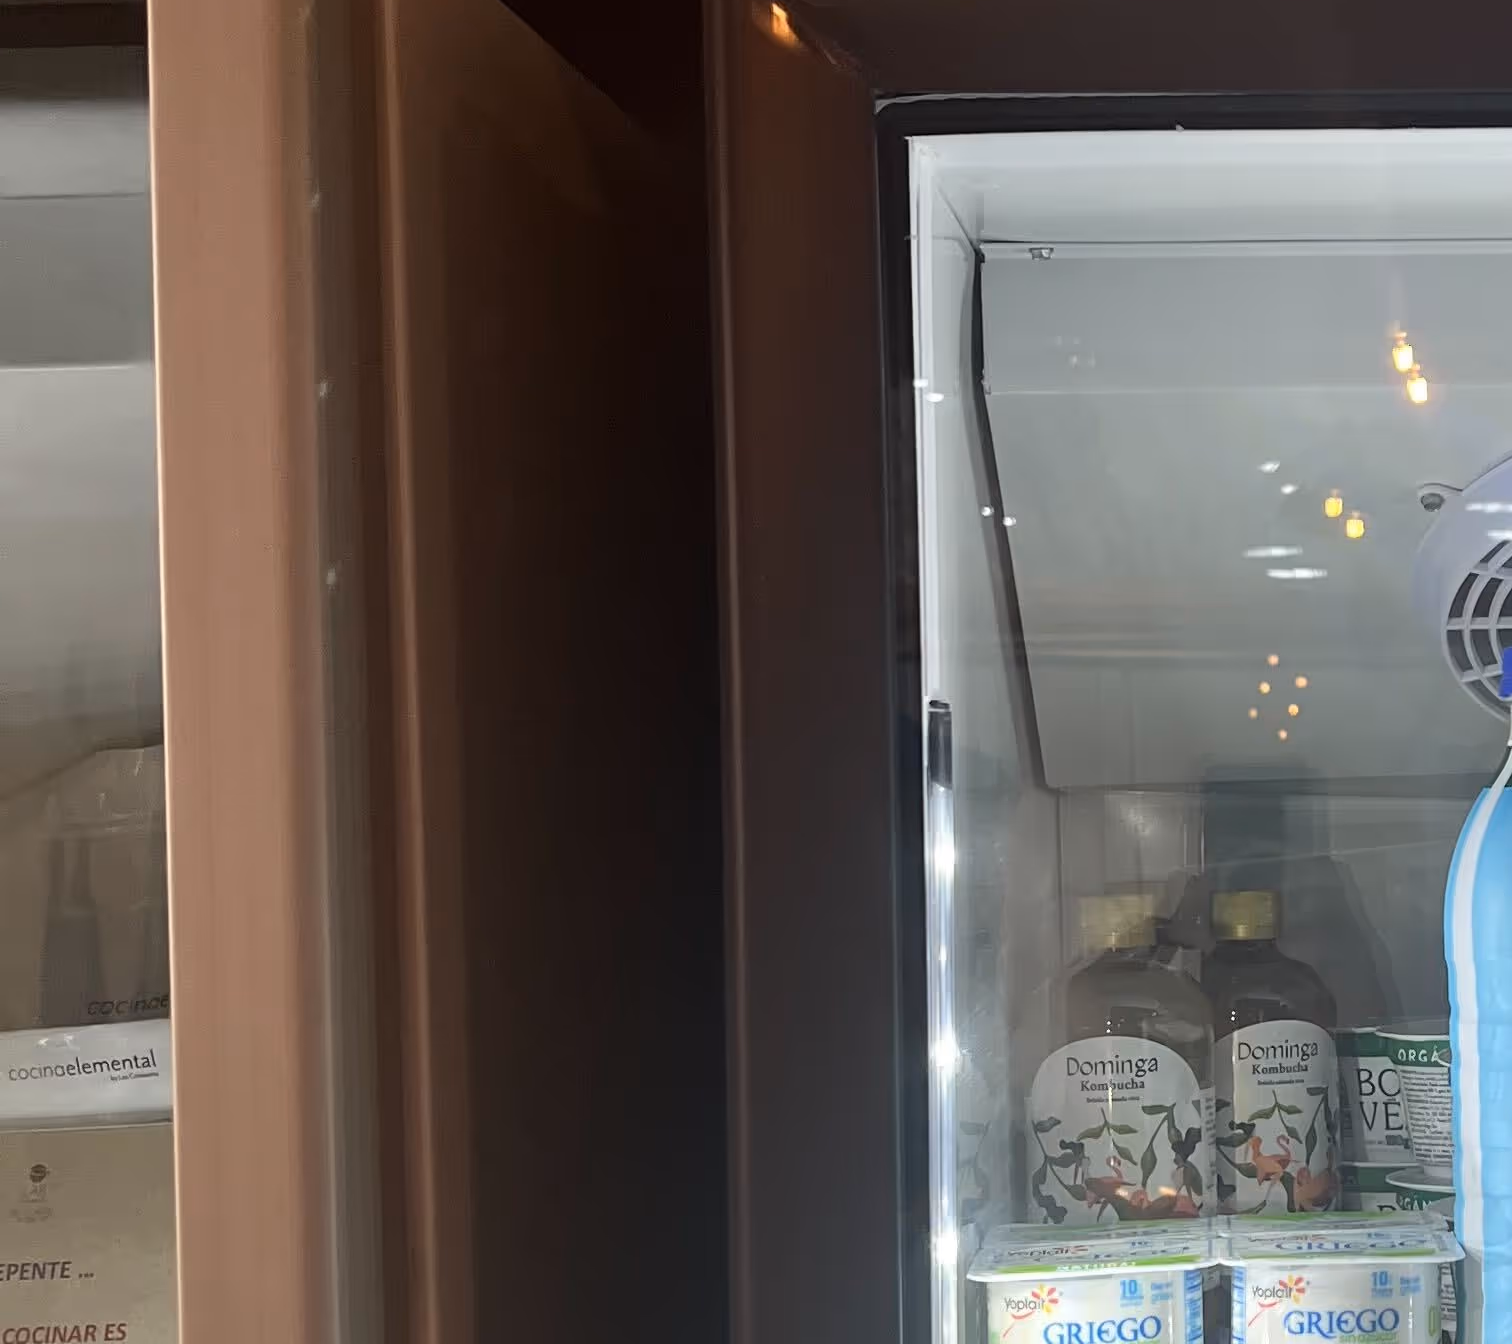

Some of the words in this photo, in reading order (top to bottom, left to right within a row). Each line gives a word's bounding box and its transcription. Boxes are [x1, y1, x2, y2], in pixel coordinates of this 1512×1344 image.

[1237, 1039, 1320, 1061] Dominga
[8, 1048, 157, 1082] cocinaelemental
[1066, 1054, 1160, 1078] Dominga
[1251, 1063, 1310, 1076] Kombucha
[1080, 1079, 1146, 1092] Kombucha
[1251, 1284, 1293, 1302] Yoplait
[104, 1323, 127, 1342] ES
[1283, 1307, 1400, 1340] GRIEGO
